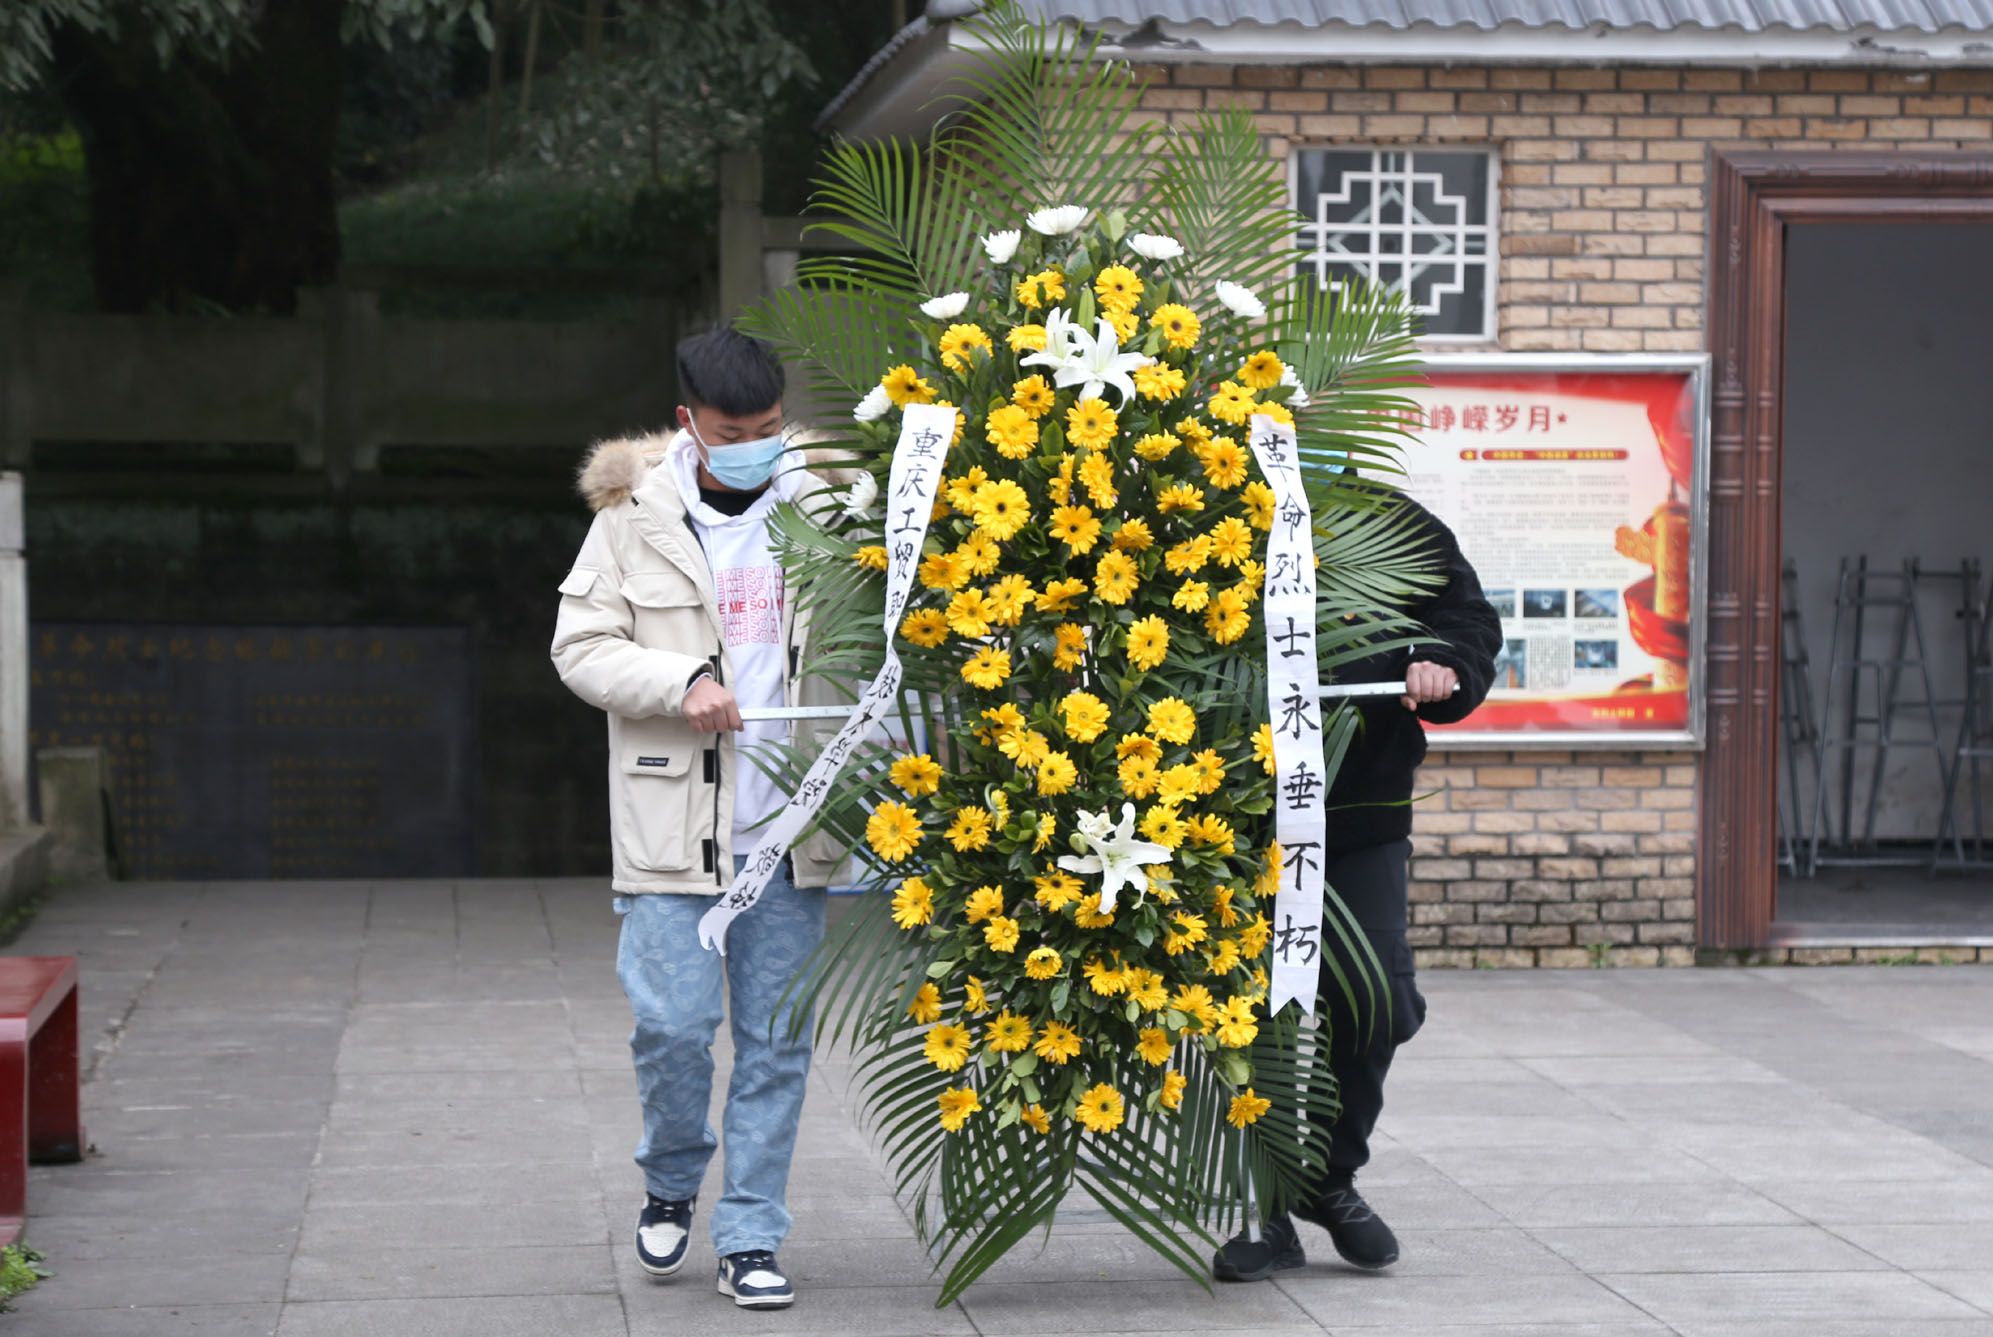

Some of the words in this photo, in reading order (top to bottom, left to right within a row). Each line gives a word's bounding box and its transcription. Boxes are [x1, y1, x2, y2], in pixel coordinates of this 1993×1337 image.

[1366, 404, 1550, 432] 国峥嵘岁月
[1259, 434, 1323, 966] 革命烈士永垂不朽
